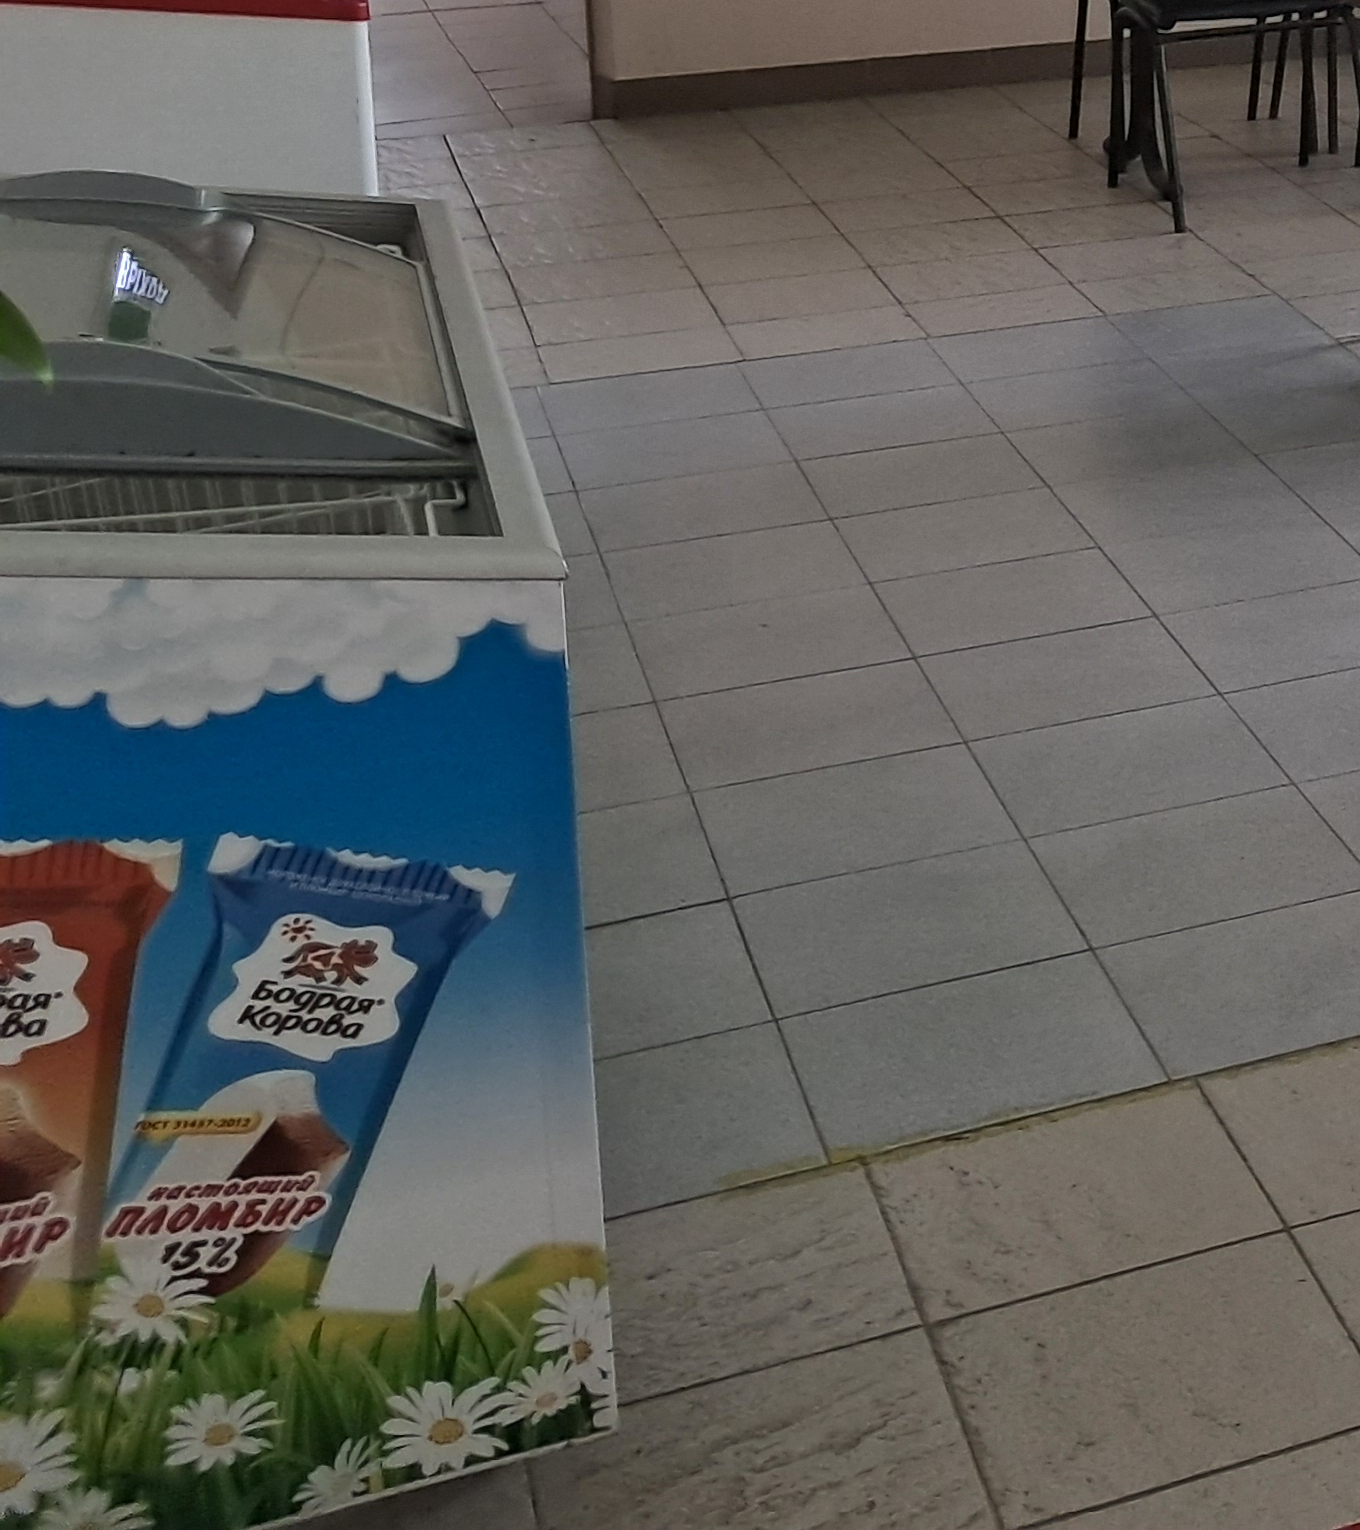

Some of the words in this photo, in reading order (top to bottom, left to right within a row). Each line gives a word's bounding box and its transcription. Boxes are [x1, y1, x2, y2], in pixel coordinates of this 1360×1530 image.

[250, 979, 377, 1015] Бодрая
[236, 1004, 365, 1039] Корова
[134, 1120, 169, 1131] ГОСТ
[147, 1174, 317, 1202] настоящий
[104, 1195, 328, 1238] ПЛОМБИР
[161, 1236, 237, 1270] 15%
